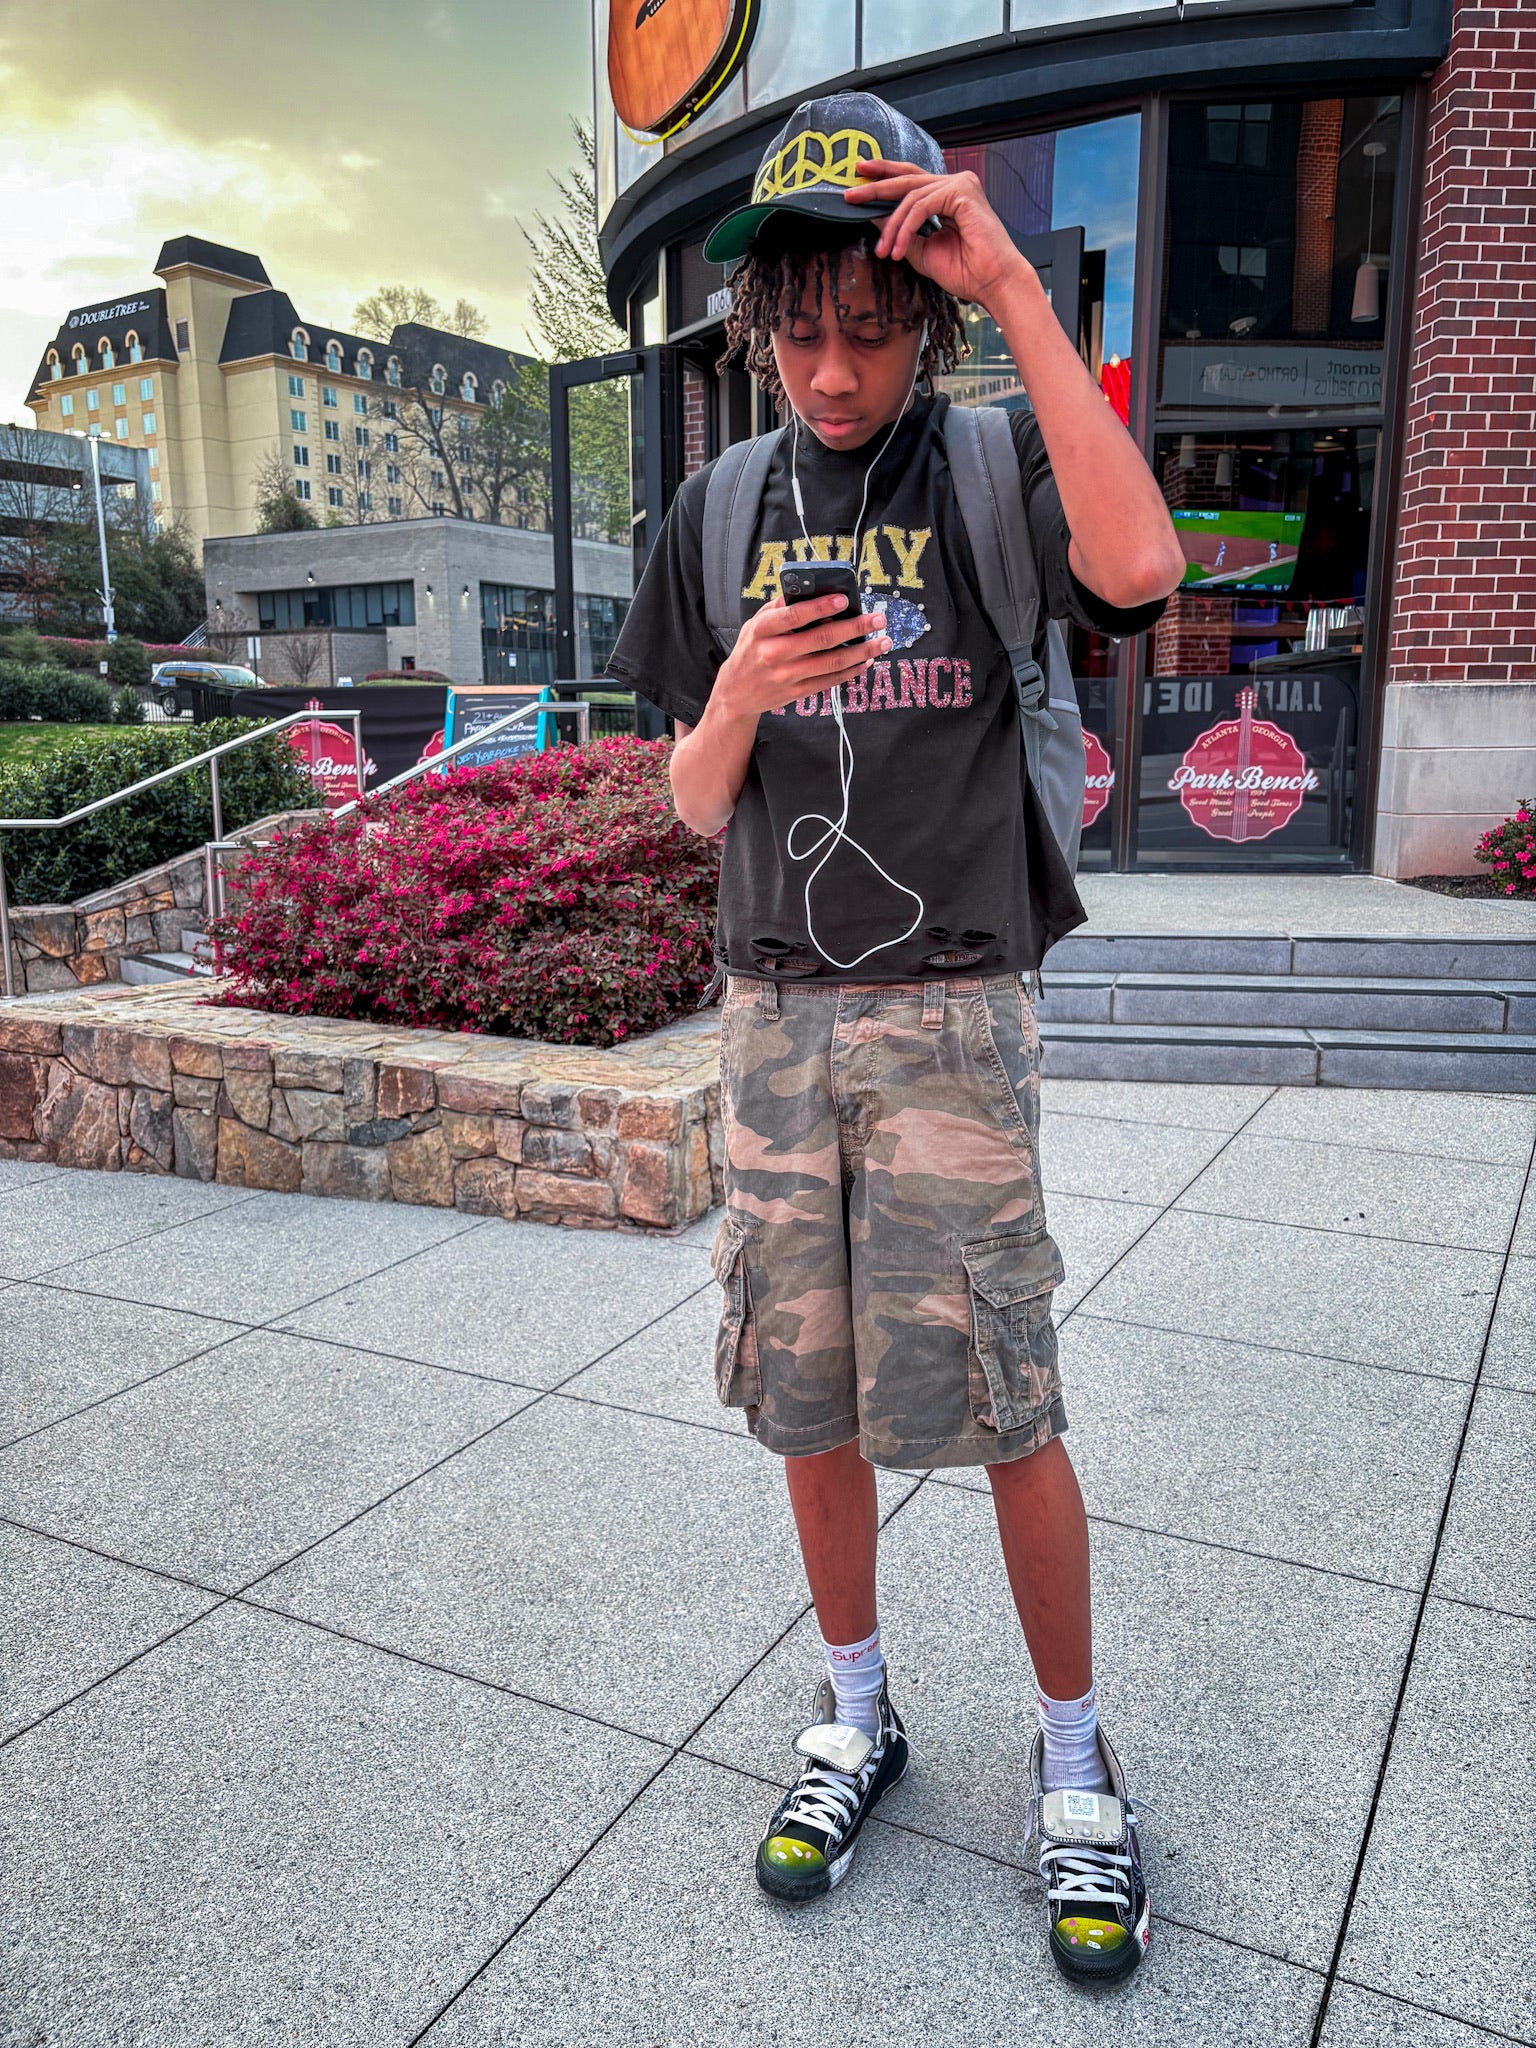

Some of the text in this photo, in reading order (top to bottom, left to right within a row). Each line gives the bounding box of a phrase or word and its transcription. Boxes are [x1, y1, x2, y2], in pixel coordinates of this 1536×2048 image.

[1201, 725, 1288, 750] ATLANTA GEORGIA
[1168, 765, 1319, 791] Park Bench
[1189, 799, 1208, 807] Good
[1250, 799, 1269, 807] Good
[1270, 799, 1293, 807] Times
[1247, 808, 1275, 819] People
